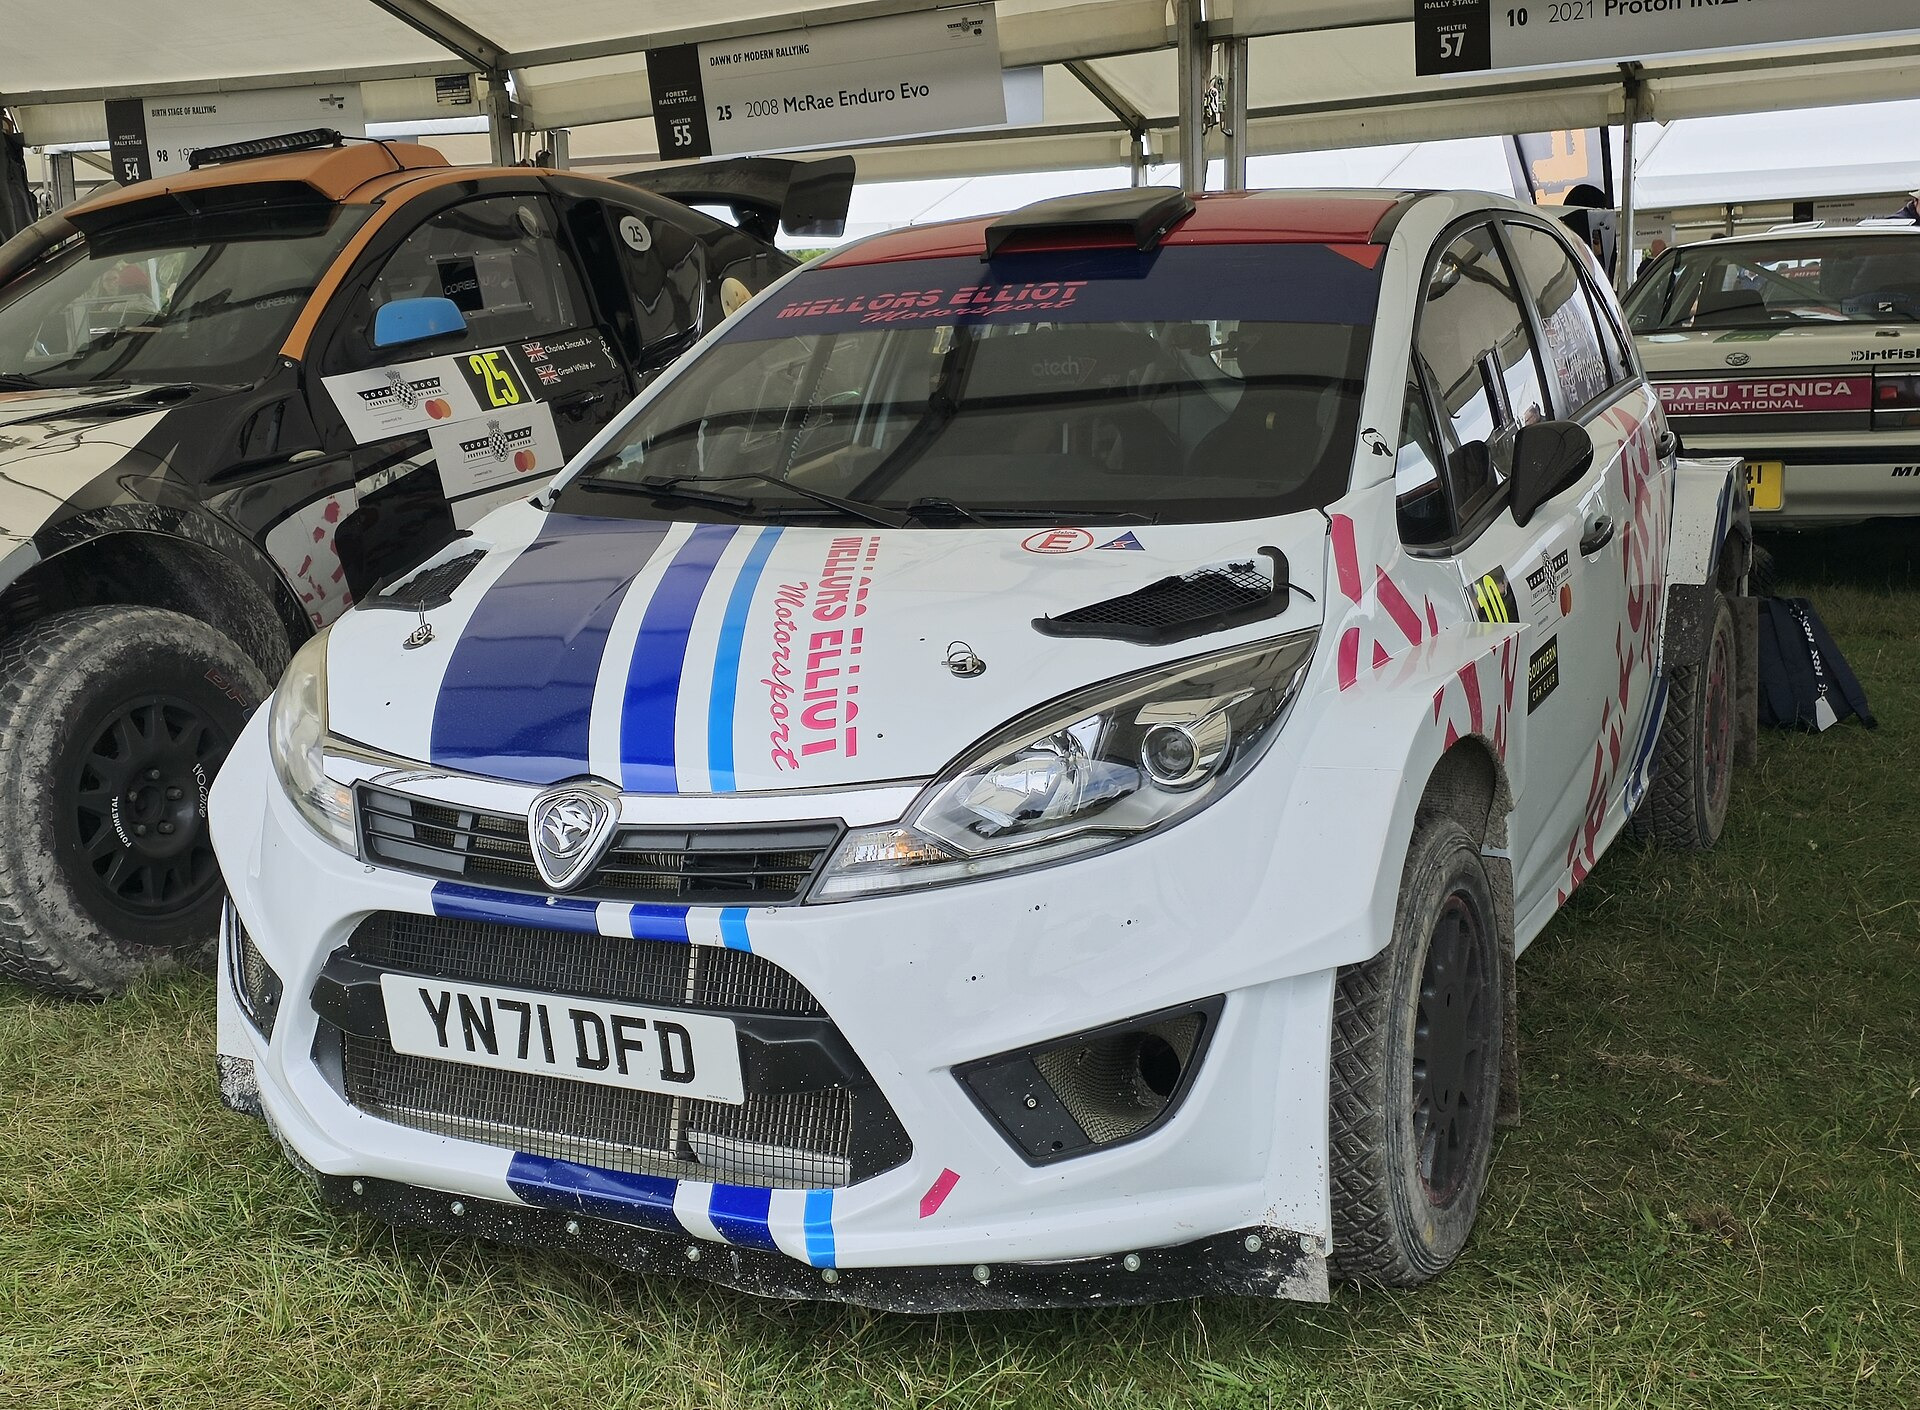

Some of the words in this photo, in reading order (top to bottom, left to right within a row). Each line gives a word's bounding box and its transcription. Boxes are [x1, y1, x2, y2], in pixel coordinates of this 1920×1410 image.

[1424, 1, 1451, 10] RALLY
[1507, 8, 1528, 27] 10
[1548, 0, 1593, 23] 2021
[1605, 0, 1681, 17] Proton
[1437, 23, 1467, 33] SHELTER
[709, 55, 731, 67] DAWN
[733, 53, 742, 63] OF
[744, 48, 774, 62] MODERN
[776, 44, 810, 58] RALLYING
[1440, 32, 1465, 59] 57
[658, 97, 678, 106] RALLY
[677, 95, 697, 104] STAGE
[666, 89, 688, 98] FOREST
[716, 105, 733, 121] 25
[745, 99, 779, 118] 2008
[783, 94, 834, 114] McRae
[838, 86, 895, 107] Enduro
[900, 82, 930, 99] Evo
[151, 108, 167, 117] BIRTH
[167, 107, 183, 116] STAGE
[184, 106, 191, 115] OF
[192, 105, 217, 115] RALLYING
[670, 117, 692, 125] SHELTER
[673, 125, 692, 147] 55
[156, 149, 169, 162] 98
[124, 163, 140, 181] 54
[628, 226, 644, 243] 25
[776, 289, 943, 319] MELLORS
[948, 280, 1089, 305] ELLIOT
[859, 298, 1077, 325] Motorsport
[544, 343, 566, 354] Charles
[468, 352, 519, 407] 25
[557, 366, 575, 376] Grant
[363, 388, 391, 399] GOOD
[1738, 381, 1851, 399] TECNICA
[1668, 399, 1804, 412] INTERNATIONAL
[464, 440, 488, 450] GOOD
[812, 536, 881, 622] MELLORS
[1476, 574, 1509, 623] 10
[1529, 644, 1556, 682] SOUTHERN
[760, 580, 810, 773] Motorsport
[1532, 686, 1542, 702] CAR
[1543, 673, 1555, 691] CLUB
[800, 627, 864, 759] ELLIOT
[111, 796, 133, 848] FONDMETAL
[418, 987, 556, 1065] YN71
[568, 1008, 696, 1084] DFD
